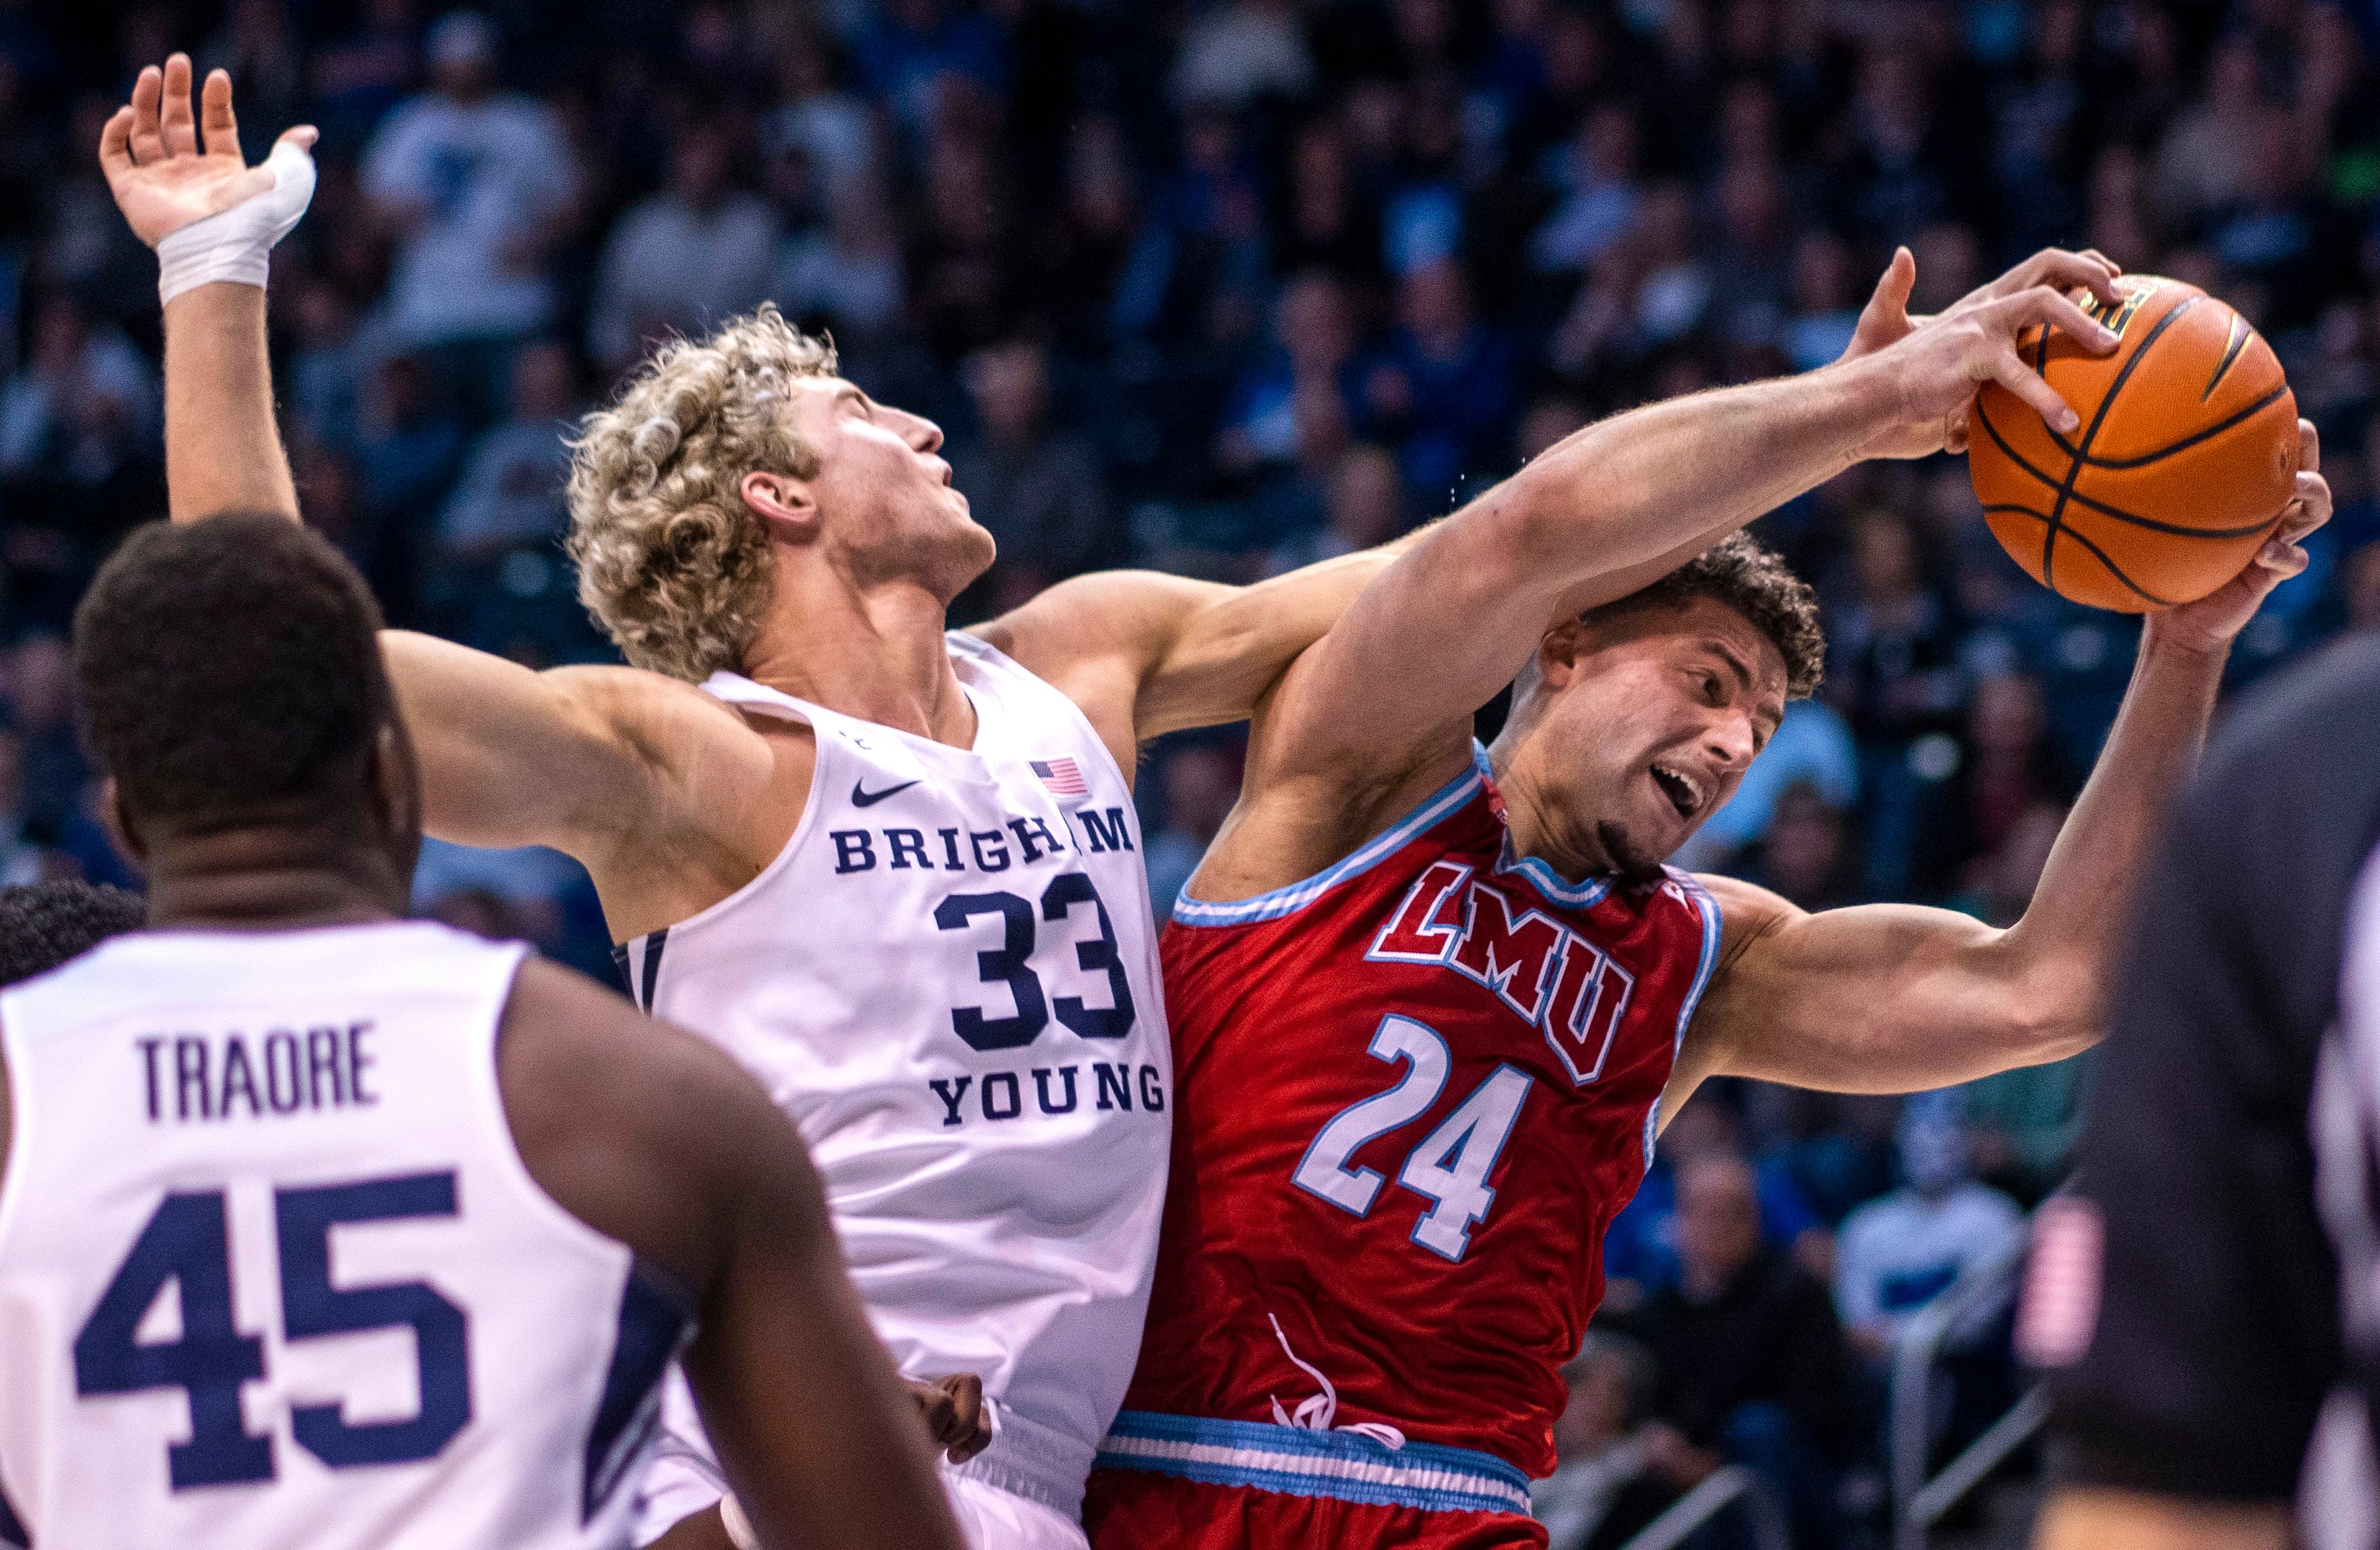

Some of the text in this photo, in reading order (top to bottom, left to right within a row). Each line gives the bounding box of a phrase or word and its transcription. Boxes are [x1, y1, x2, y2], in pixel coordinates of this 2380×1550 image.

[830, 807, 1134, 874] BRIGHM
[934, 872, 1136, 1053] 33
[1363, 860, 1635, 1087] LMU
[135, 1022, 380, 1122] TRAORE
[929, 1063, 1165, 1126] YOUNG
[1290, 1013, 1534, 1263] 24
[74, 1169, 474, 1492] 45
